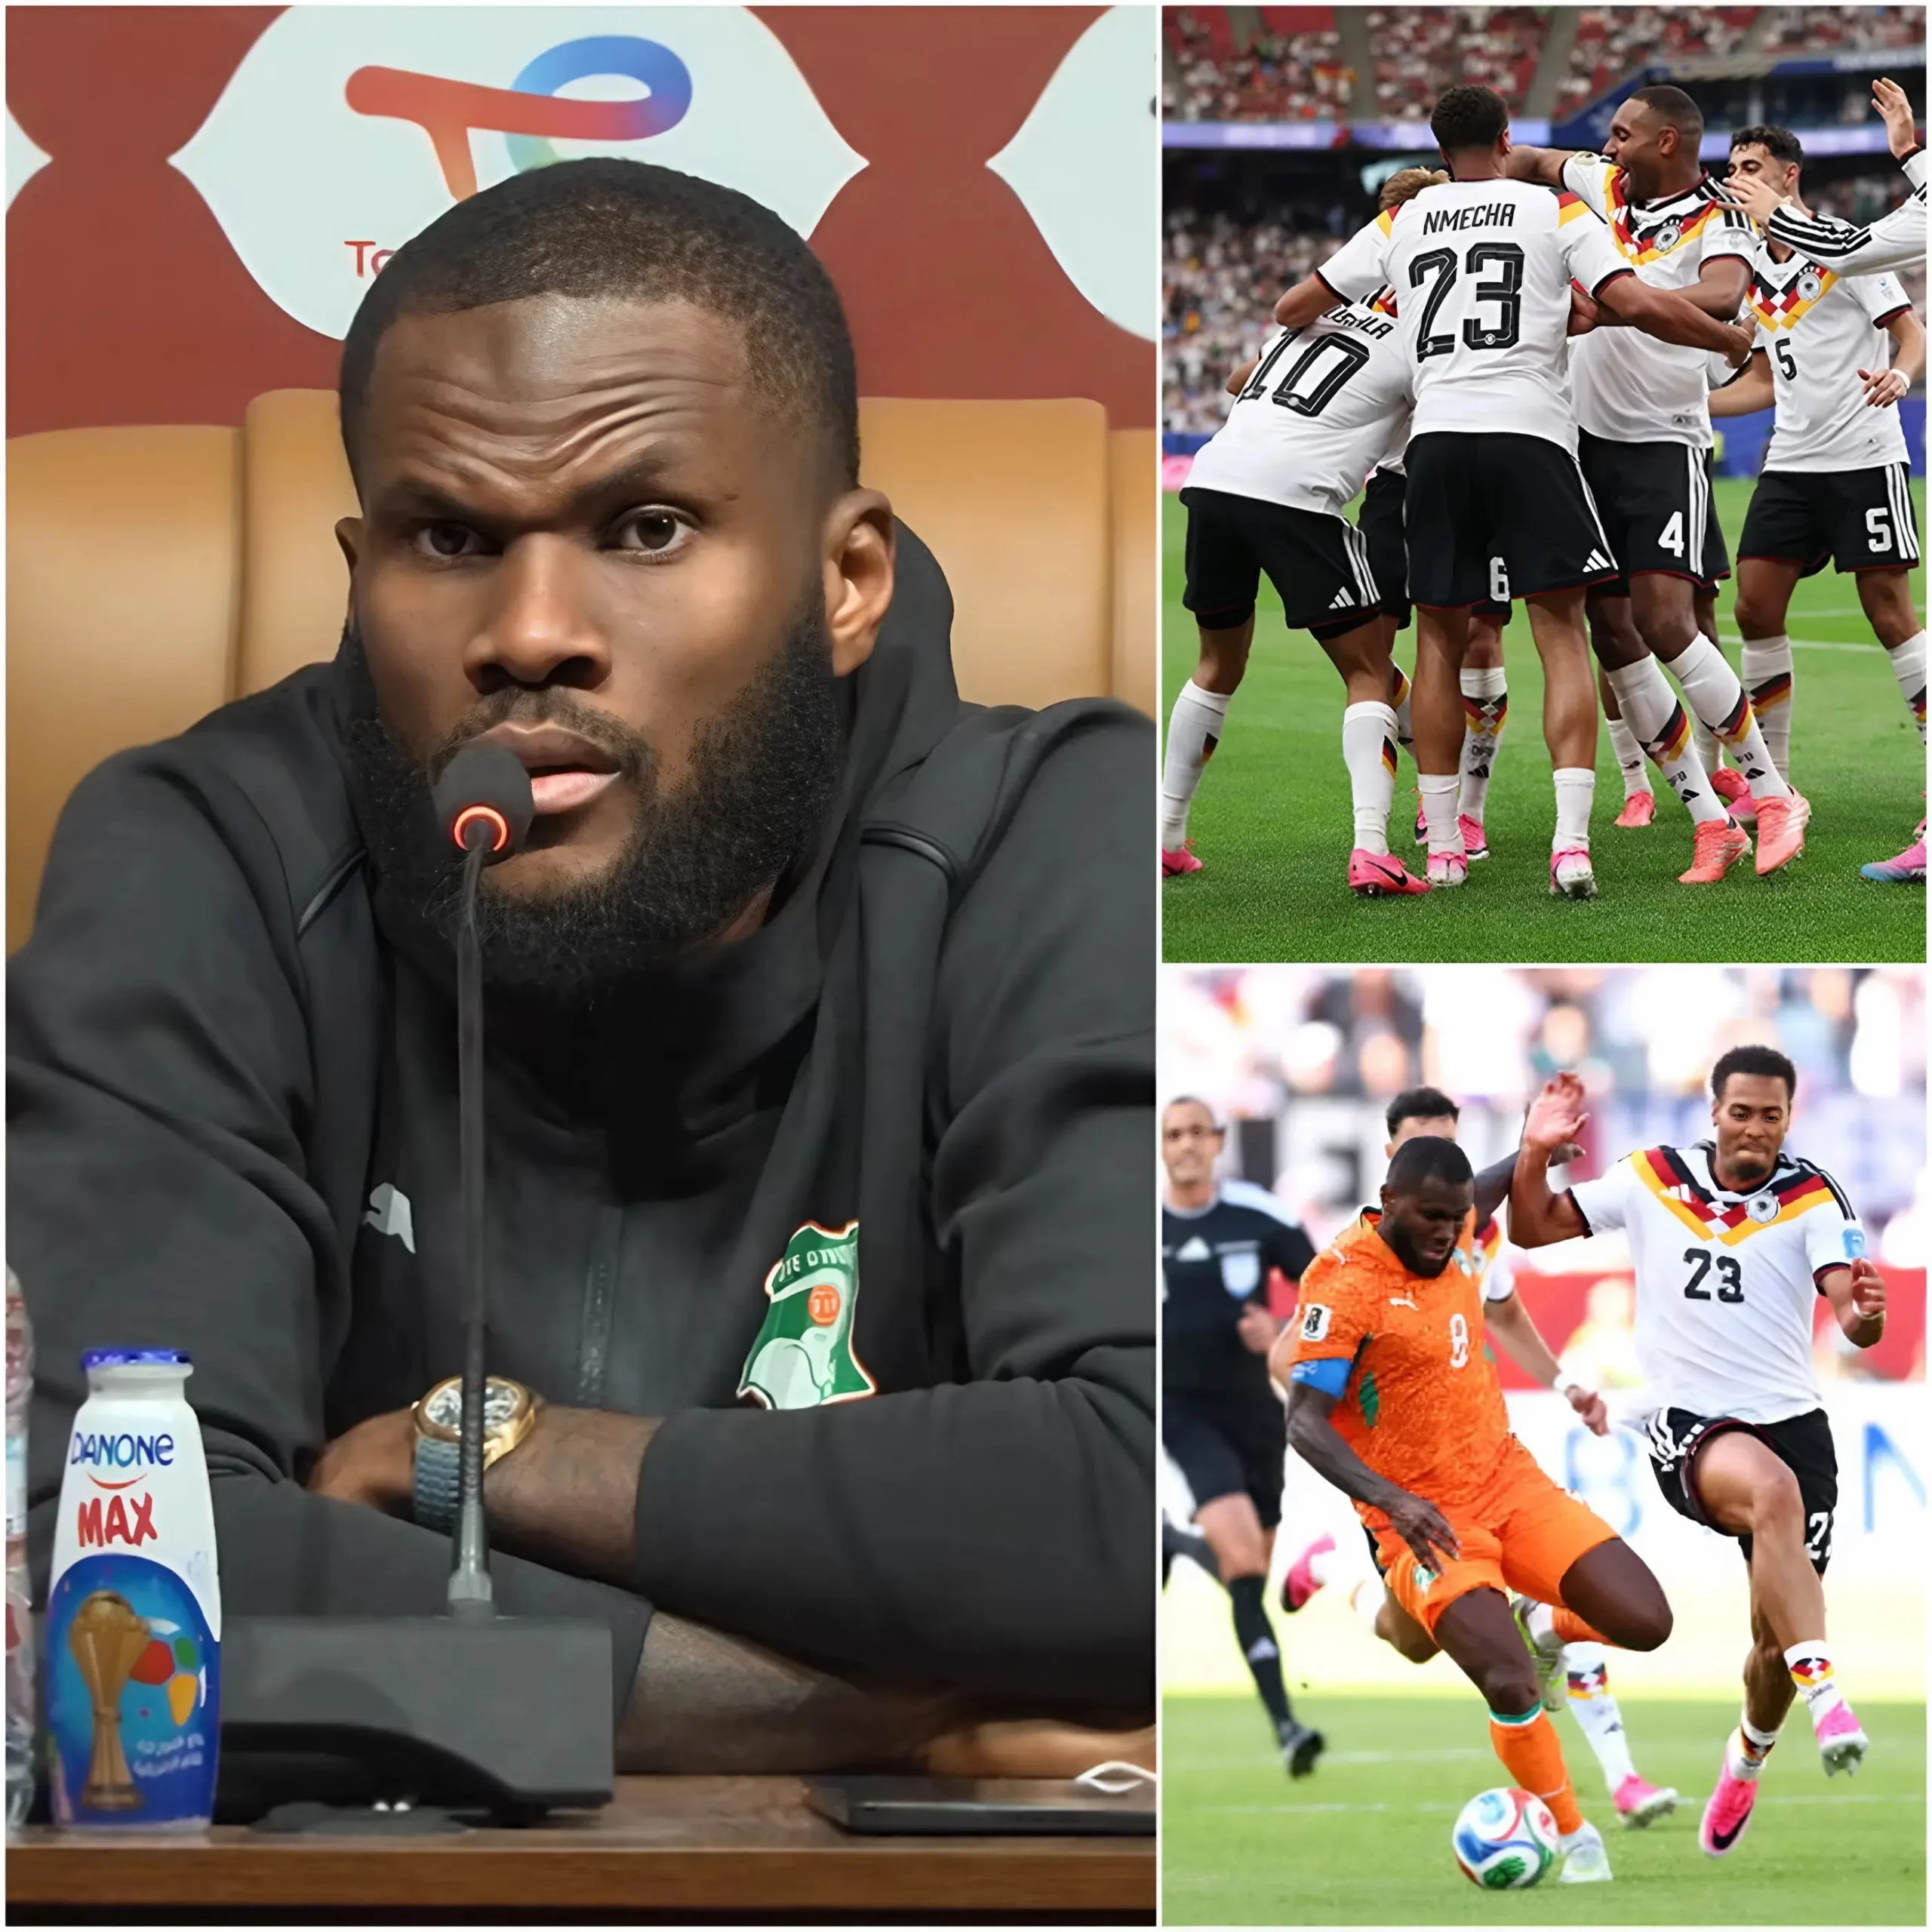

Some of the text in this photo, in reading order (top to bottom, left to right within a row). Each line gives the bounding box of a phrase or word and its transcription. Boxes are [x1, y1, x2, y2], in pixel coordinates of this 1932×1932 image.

[1423, 202, 1516, 235] NMECHA
[1408, 242, 1525, 363] 23
[1236, 327, 1370, 417] 10
[1774, 337, 1797, 381] 5
[1658, 511, 1684, 558] 4
[1865, 507, 1892, 552] 5
[1490, 556, 1510, 602] 6
[1683, 1247, 1744, 1303] 23
[78, 1491, 158, 1548] MAX
[1804, 1512, 1832, 1560] 2
